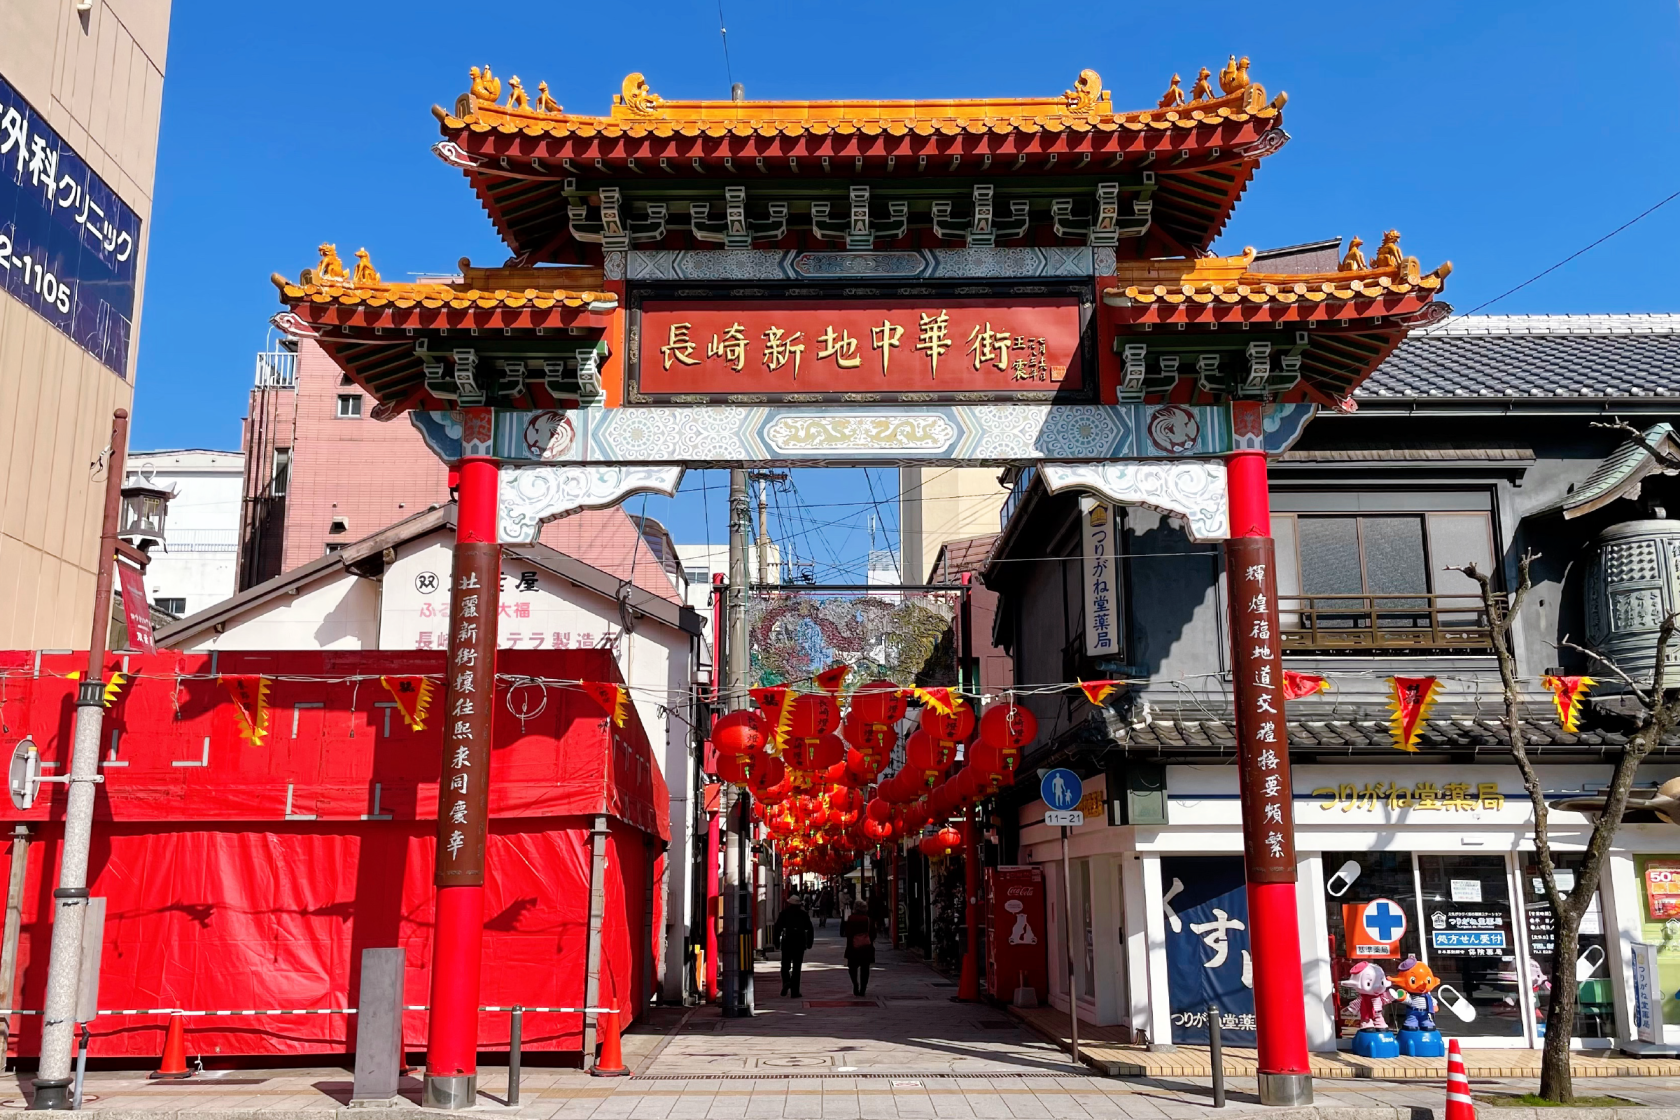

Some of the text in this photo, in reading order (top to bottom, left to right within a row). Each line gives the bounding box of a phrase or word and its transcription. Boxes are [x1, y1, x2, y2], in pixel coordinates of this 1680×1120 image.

[0, 103, 133, 262] 外科クリニック
[659, 309, 1012, 380] 長崎新地中華街
[1091, 530, 1112, 649] つりがね堂薬局
[415, 631, 619, 650] 長崎テラ製造元
[1312, 781, 1505, 812] つりがね堂薬局
[1047, 813, 1082, 823] 11-21
[1436, 934, 1502, 945] 処方せん受付
[1171, 1012, 1257, 1031] つりが堂薬
